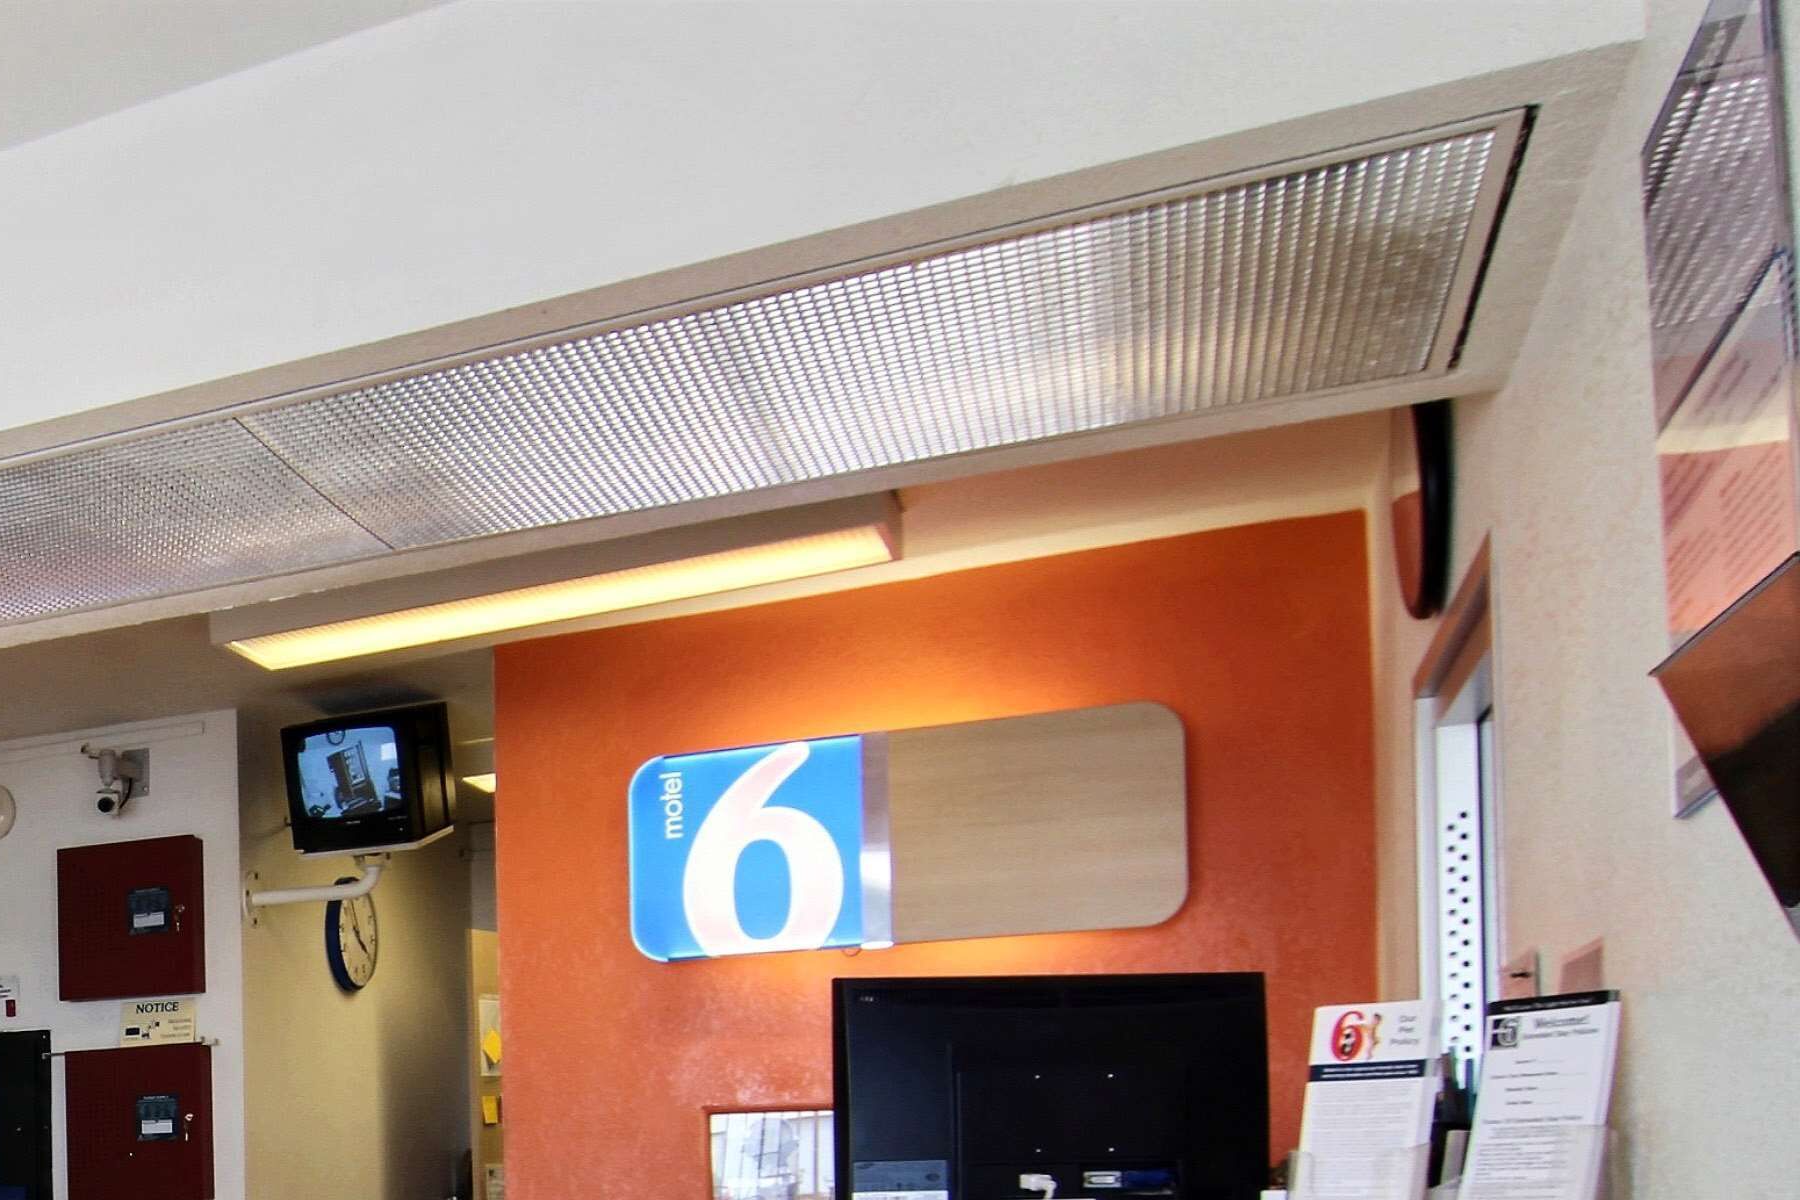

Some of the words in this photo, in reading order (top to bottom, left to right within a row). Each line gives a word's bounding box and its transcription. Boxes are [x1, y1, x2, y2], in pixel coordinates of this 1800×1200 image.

[659, 771, 684, 839] motel
[683, 741, 845, 957] 6
[136, 1001, 179, 1014] NOTICE
